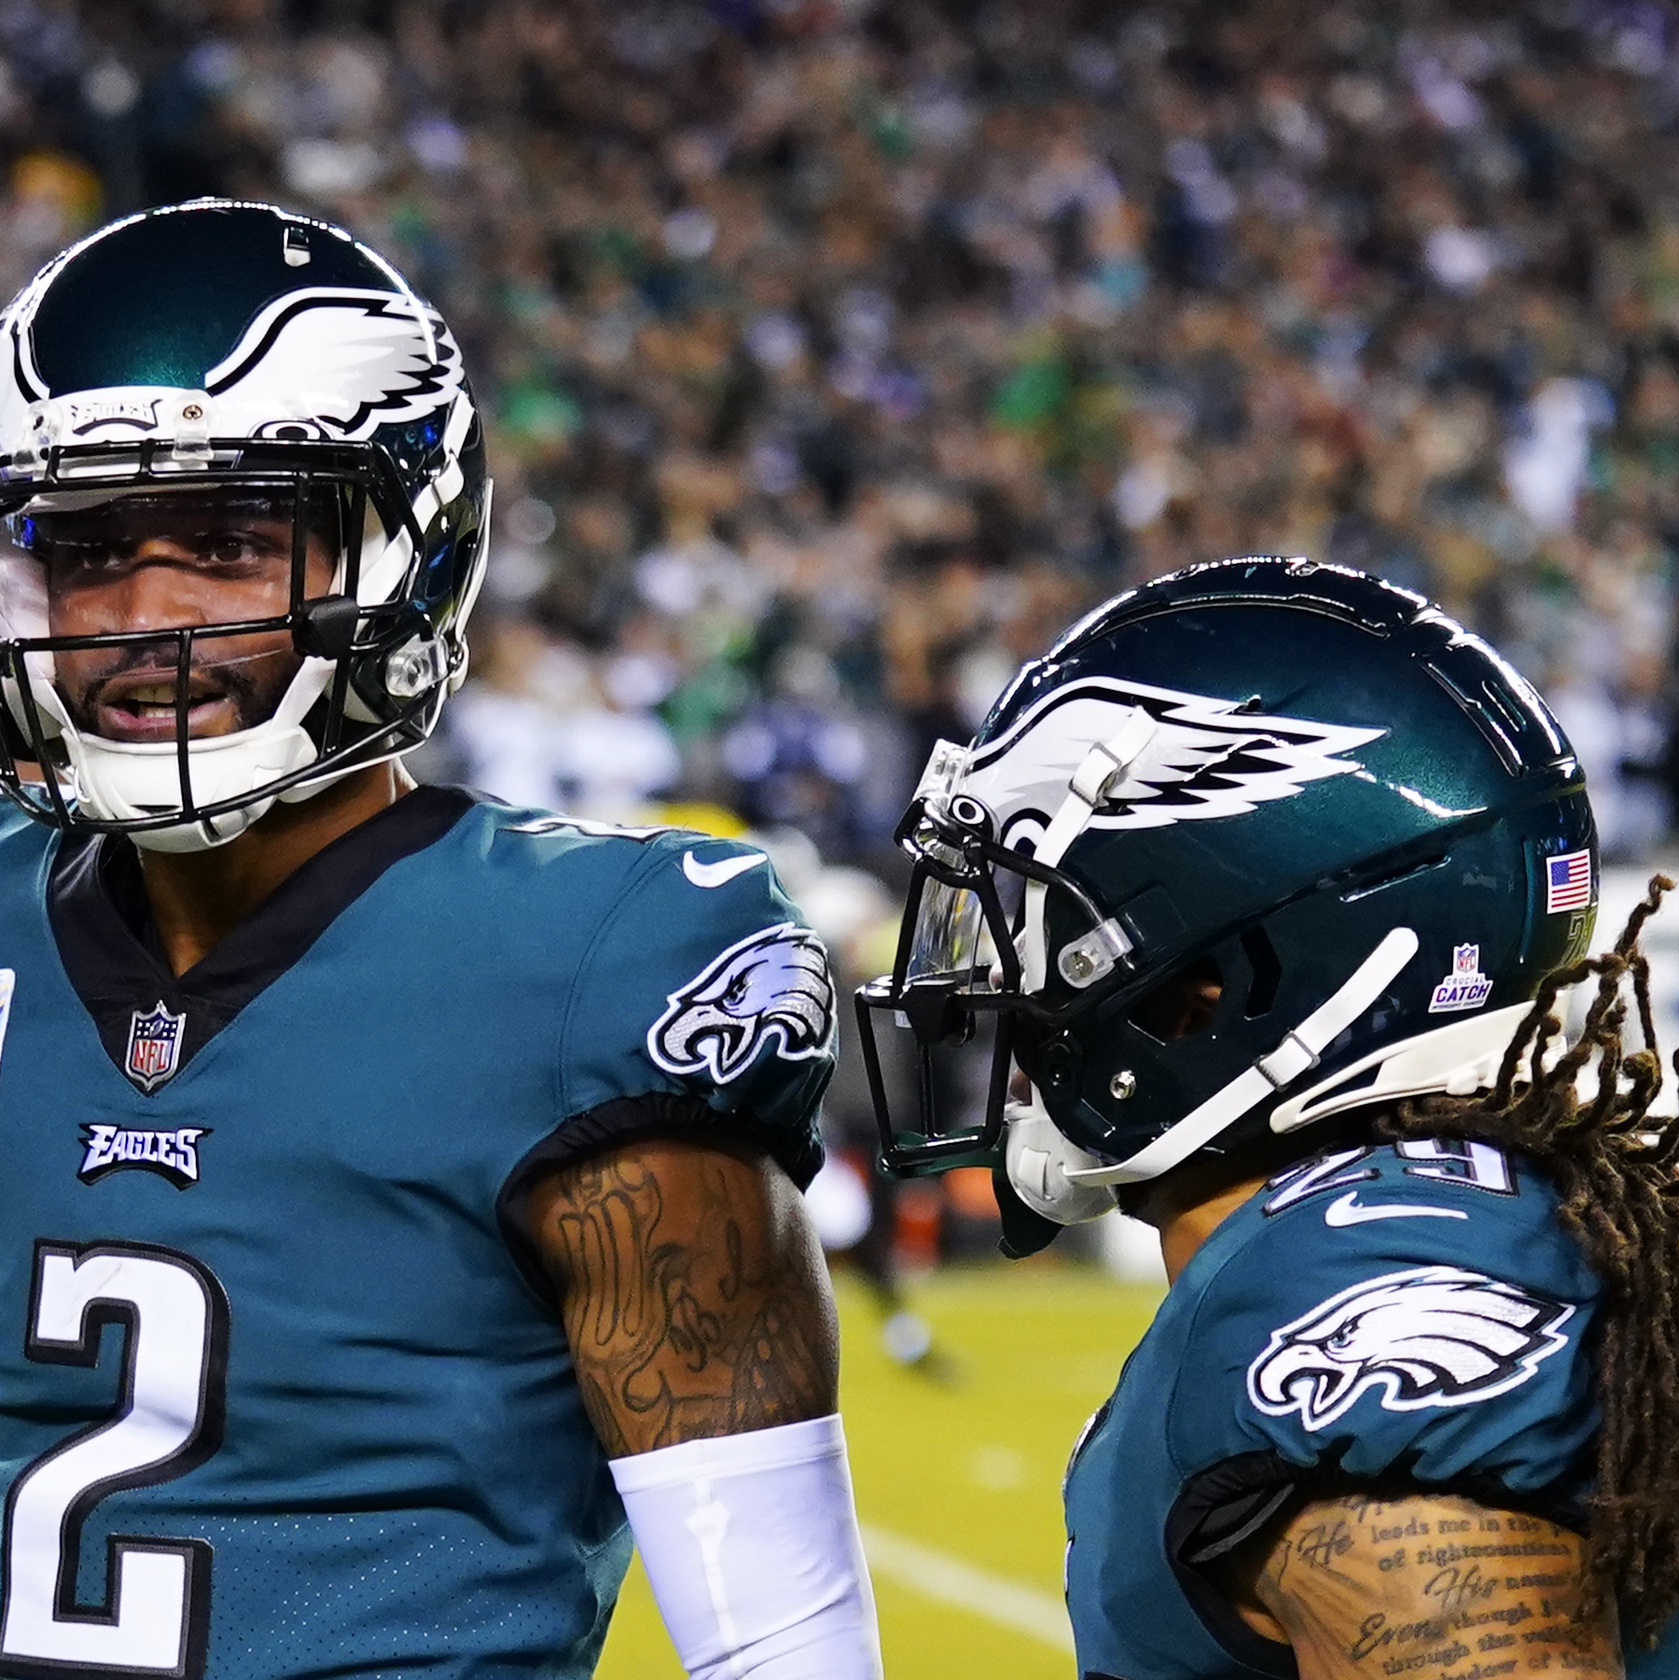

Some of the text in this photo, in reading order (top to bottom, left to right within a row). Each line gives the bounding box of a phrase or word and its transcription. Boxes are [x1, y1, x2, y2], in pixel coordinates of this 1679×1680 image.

[1435, 982, 1491, 1003] CATCH
[133, 1037, 170, 1074] NFL
[79, 1124, 205, 1182] EAGLES
